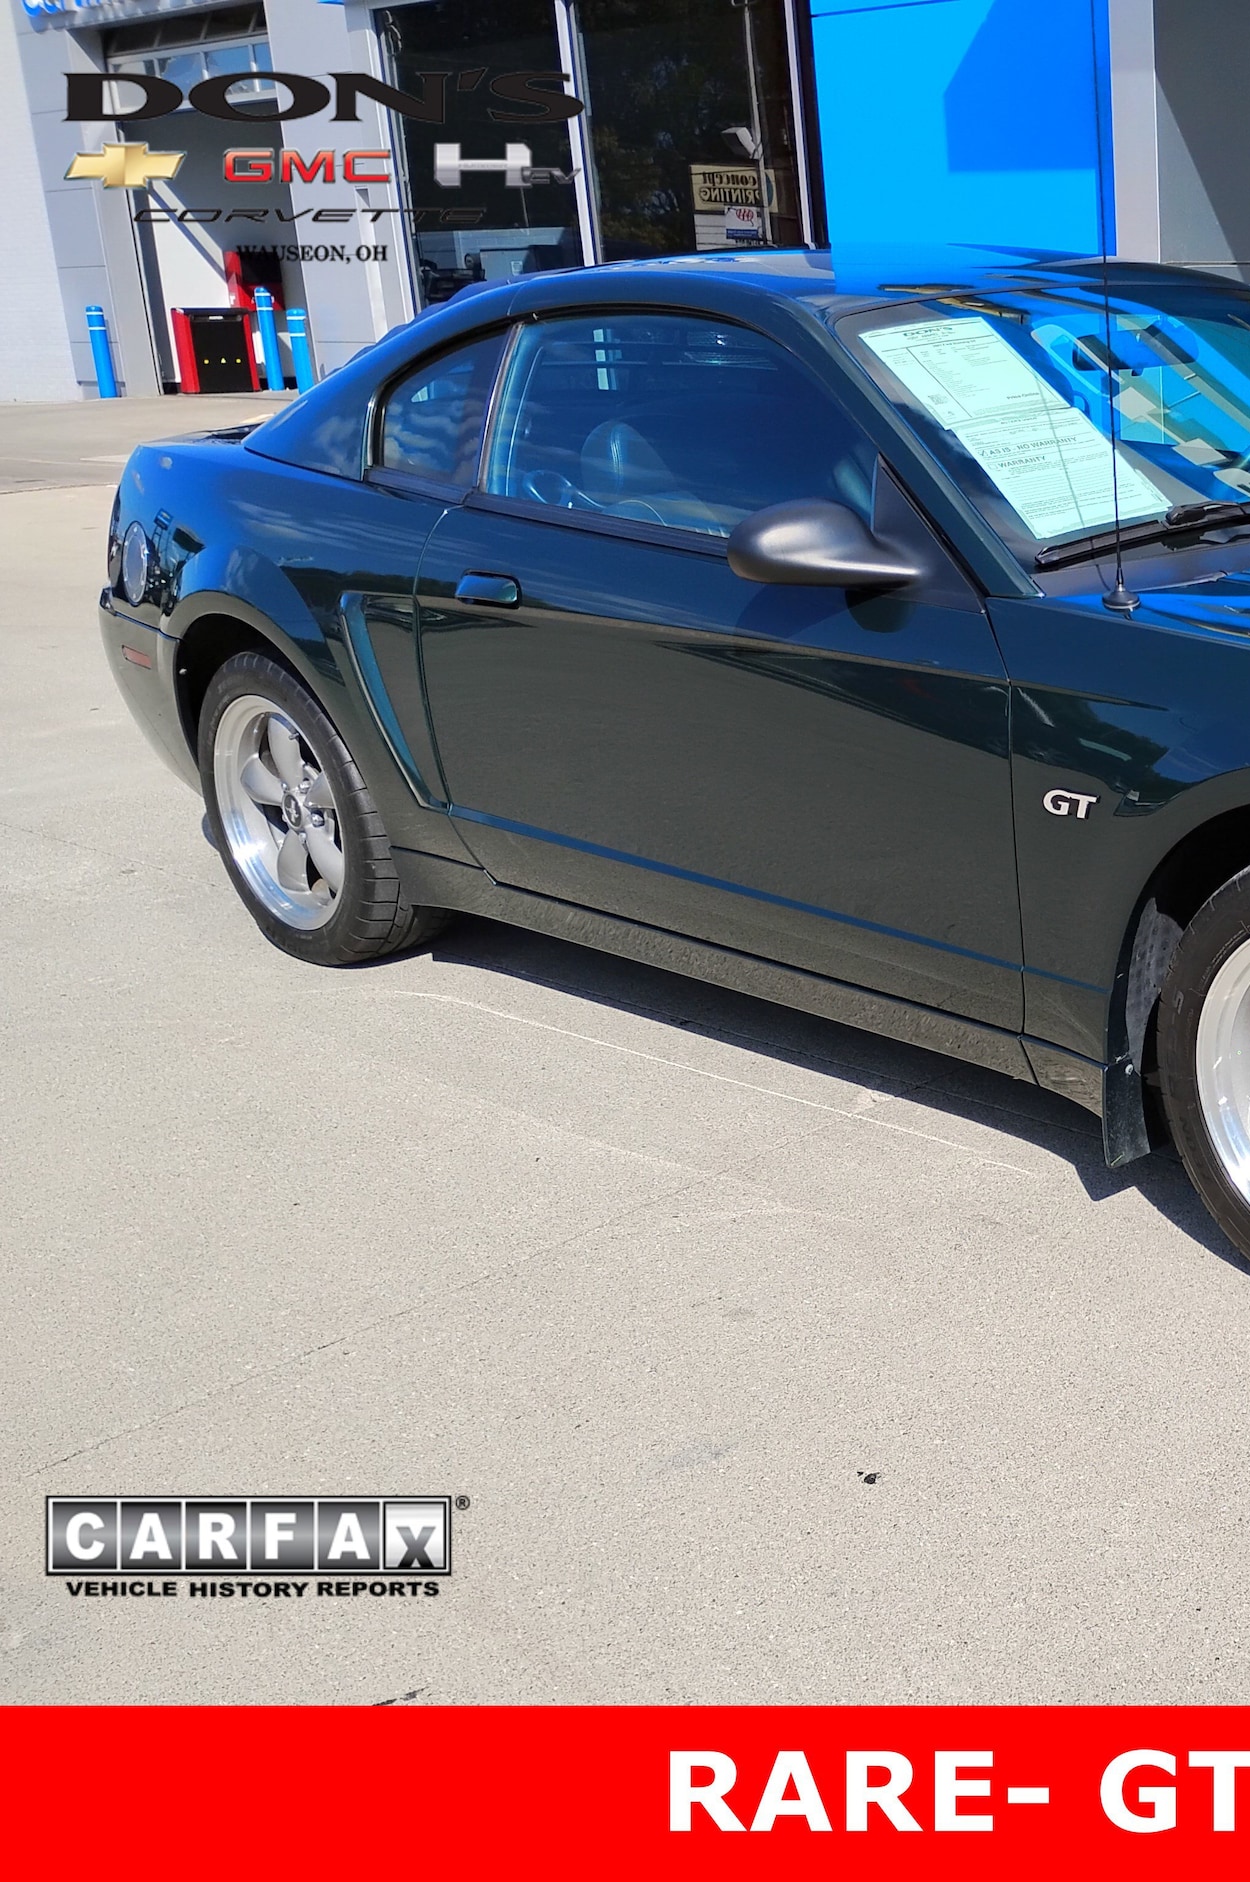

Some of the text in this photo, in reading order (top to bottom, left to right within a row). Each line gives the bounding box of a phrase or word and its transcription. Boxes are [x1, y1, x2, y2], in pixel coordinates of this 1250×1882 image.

[1030, 437, 1077, 448] WARRANTY
[997, 455, 1046, 468] WARRANTY
[1042, 789, 1098, 819] GT
